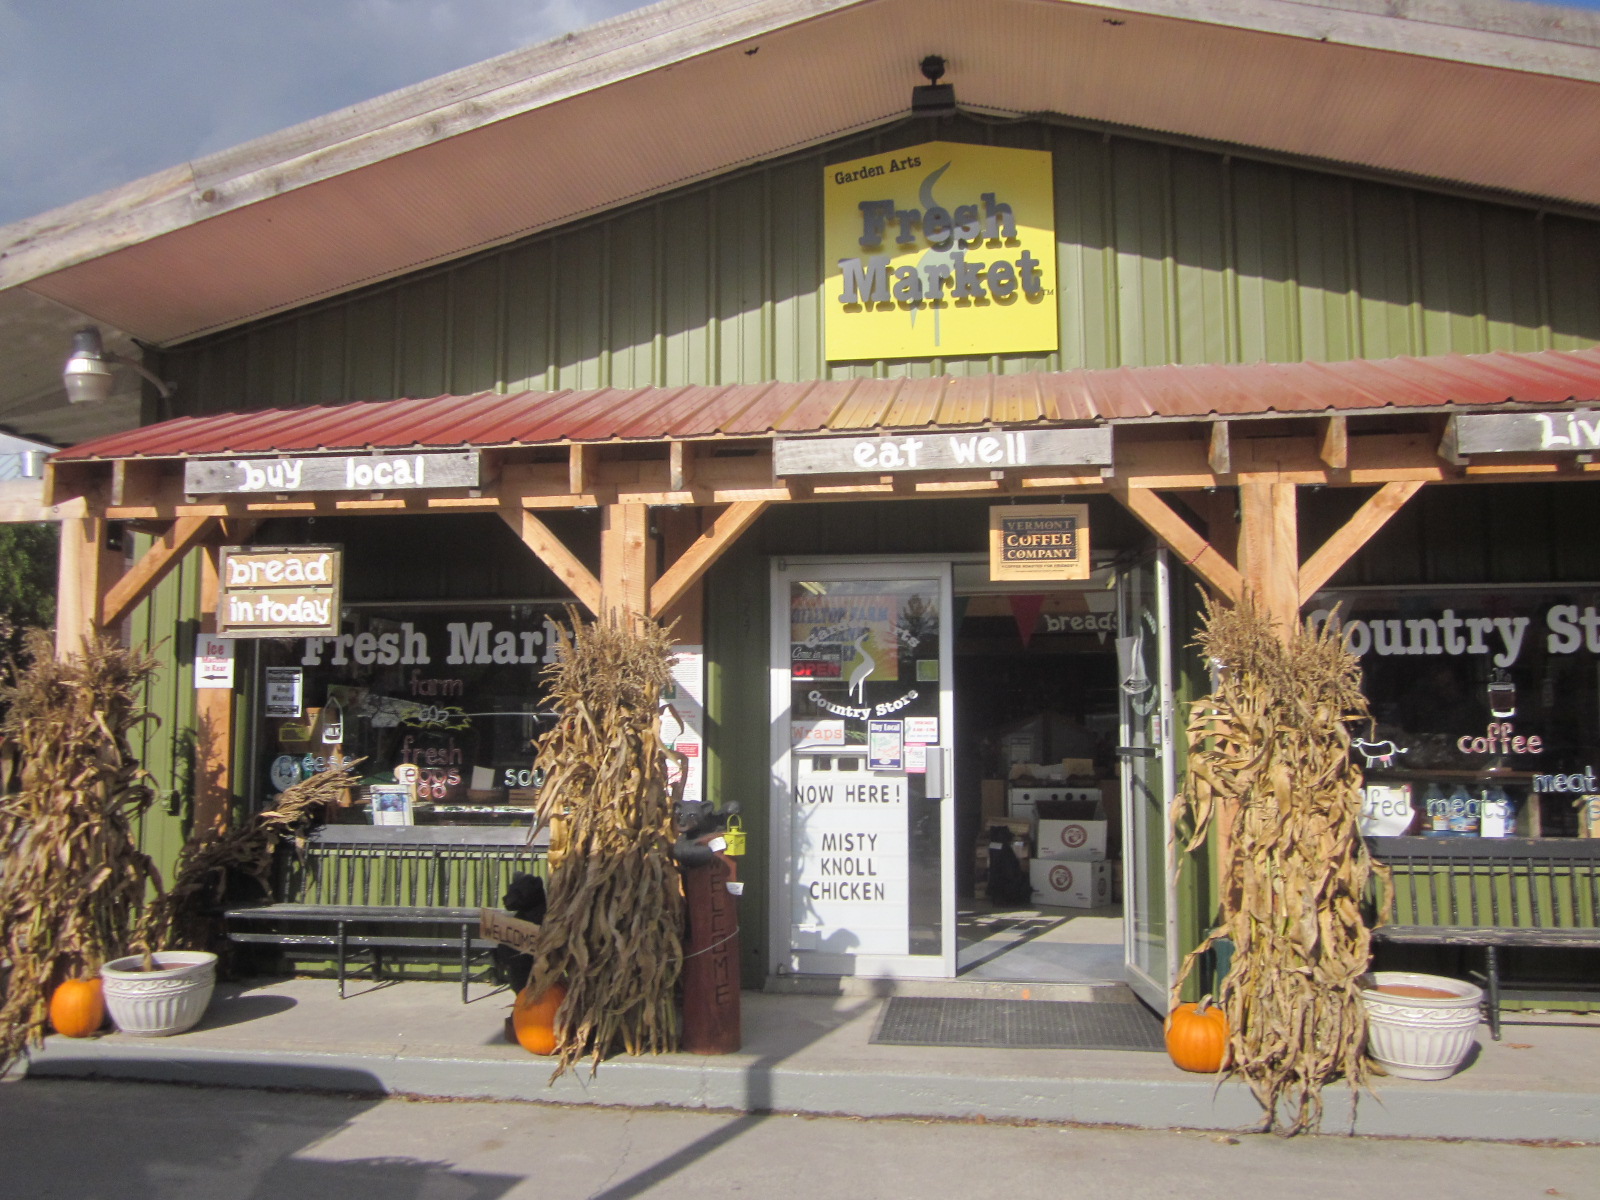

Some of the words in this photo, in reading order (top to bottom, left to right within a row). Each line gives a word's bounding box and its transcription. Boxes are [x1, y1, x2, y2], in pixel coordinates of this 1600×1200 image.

[835, 163, 885, 185] Garden
[890, 156, 921, 173] Arts
[858, 192, 1018, 246] Fresh
[838, 250, 1042, 303] Market
[853, 437, 923, 467] eat
[950, 432, 1026, 465] well
[238, 459, 303, 490] buy
[346, 456, 424, 488] local
[1007, 520, 1072, 530] VERMONT
[1007, 533, 1073, 546] COFFEE
[1007, 549, 1072, 559] COMPANY
[227, 554, 330, 584] bread
[207, 641, 224, 655] Ice
[301, 622, 430, 665] Fresh
[409, 668, 463, 695] farm
[792, 663, 841, 676] OPEN
[808, 690, 872, 720] Country
[875, 690, 918, 716] Store
[792, 726, 843, 741] Wraps
[1457, 722, 1544, 753] coffee
[401, 735, 463, 764] fresh
[406, 768, 461, 798] eggs
[1532, 766, 1598, 792] meat
[795, 785, 833, 803] NOW
[1370, 785, 1408, 817] fed
[1427, 790, 1510, 819] meats
[822, 833, 877, 851] MISTY
[821, 857, 877, 876] KNOLL
[810, 881, 884, 900] CHICKEN
[482, 914, 538, 952] WELCOME
[711, 858, 730, 1004] WELCOME
